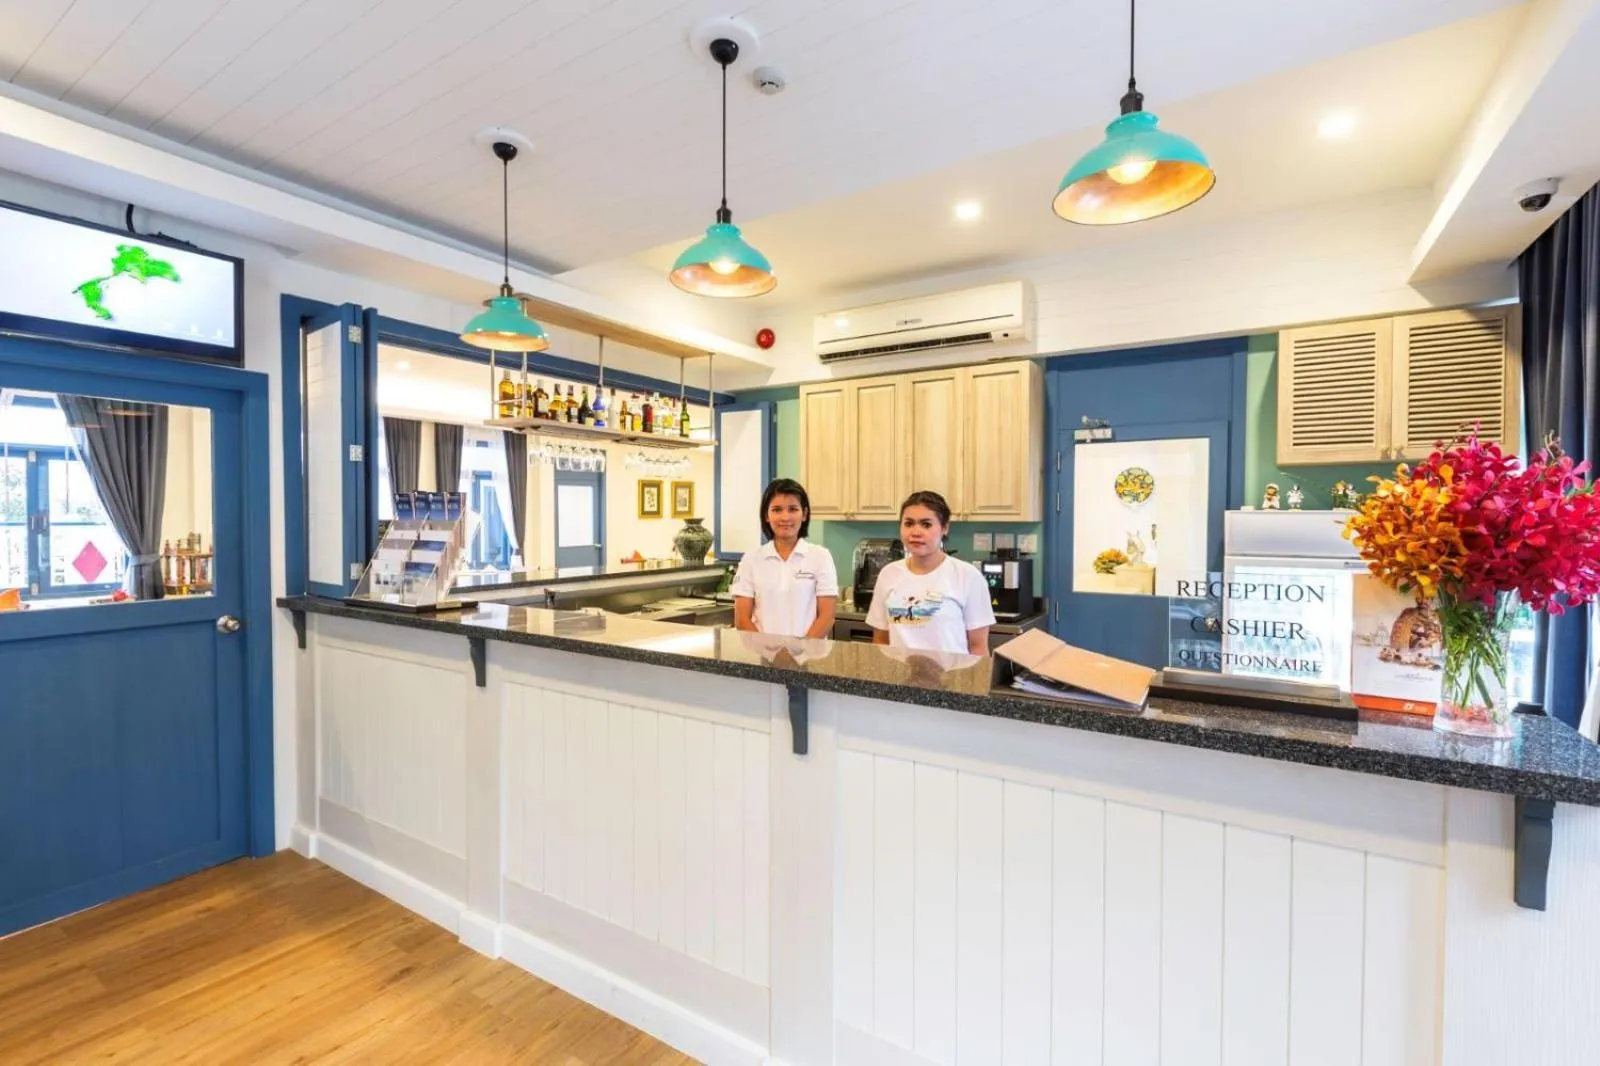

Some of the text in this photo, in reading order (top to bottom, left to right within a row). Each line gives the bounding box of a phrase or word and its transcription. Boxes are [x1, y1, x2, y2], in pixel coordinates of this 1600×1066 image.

[1177, 580, 1325, 603] RECEPTION
[1190, 616, 1306, 641] CASHIER
[1178, 649, 1323, 673] QUESTIONNAIRE
